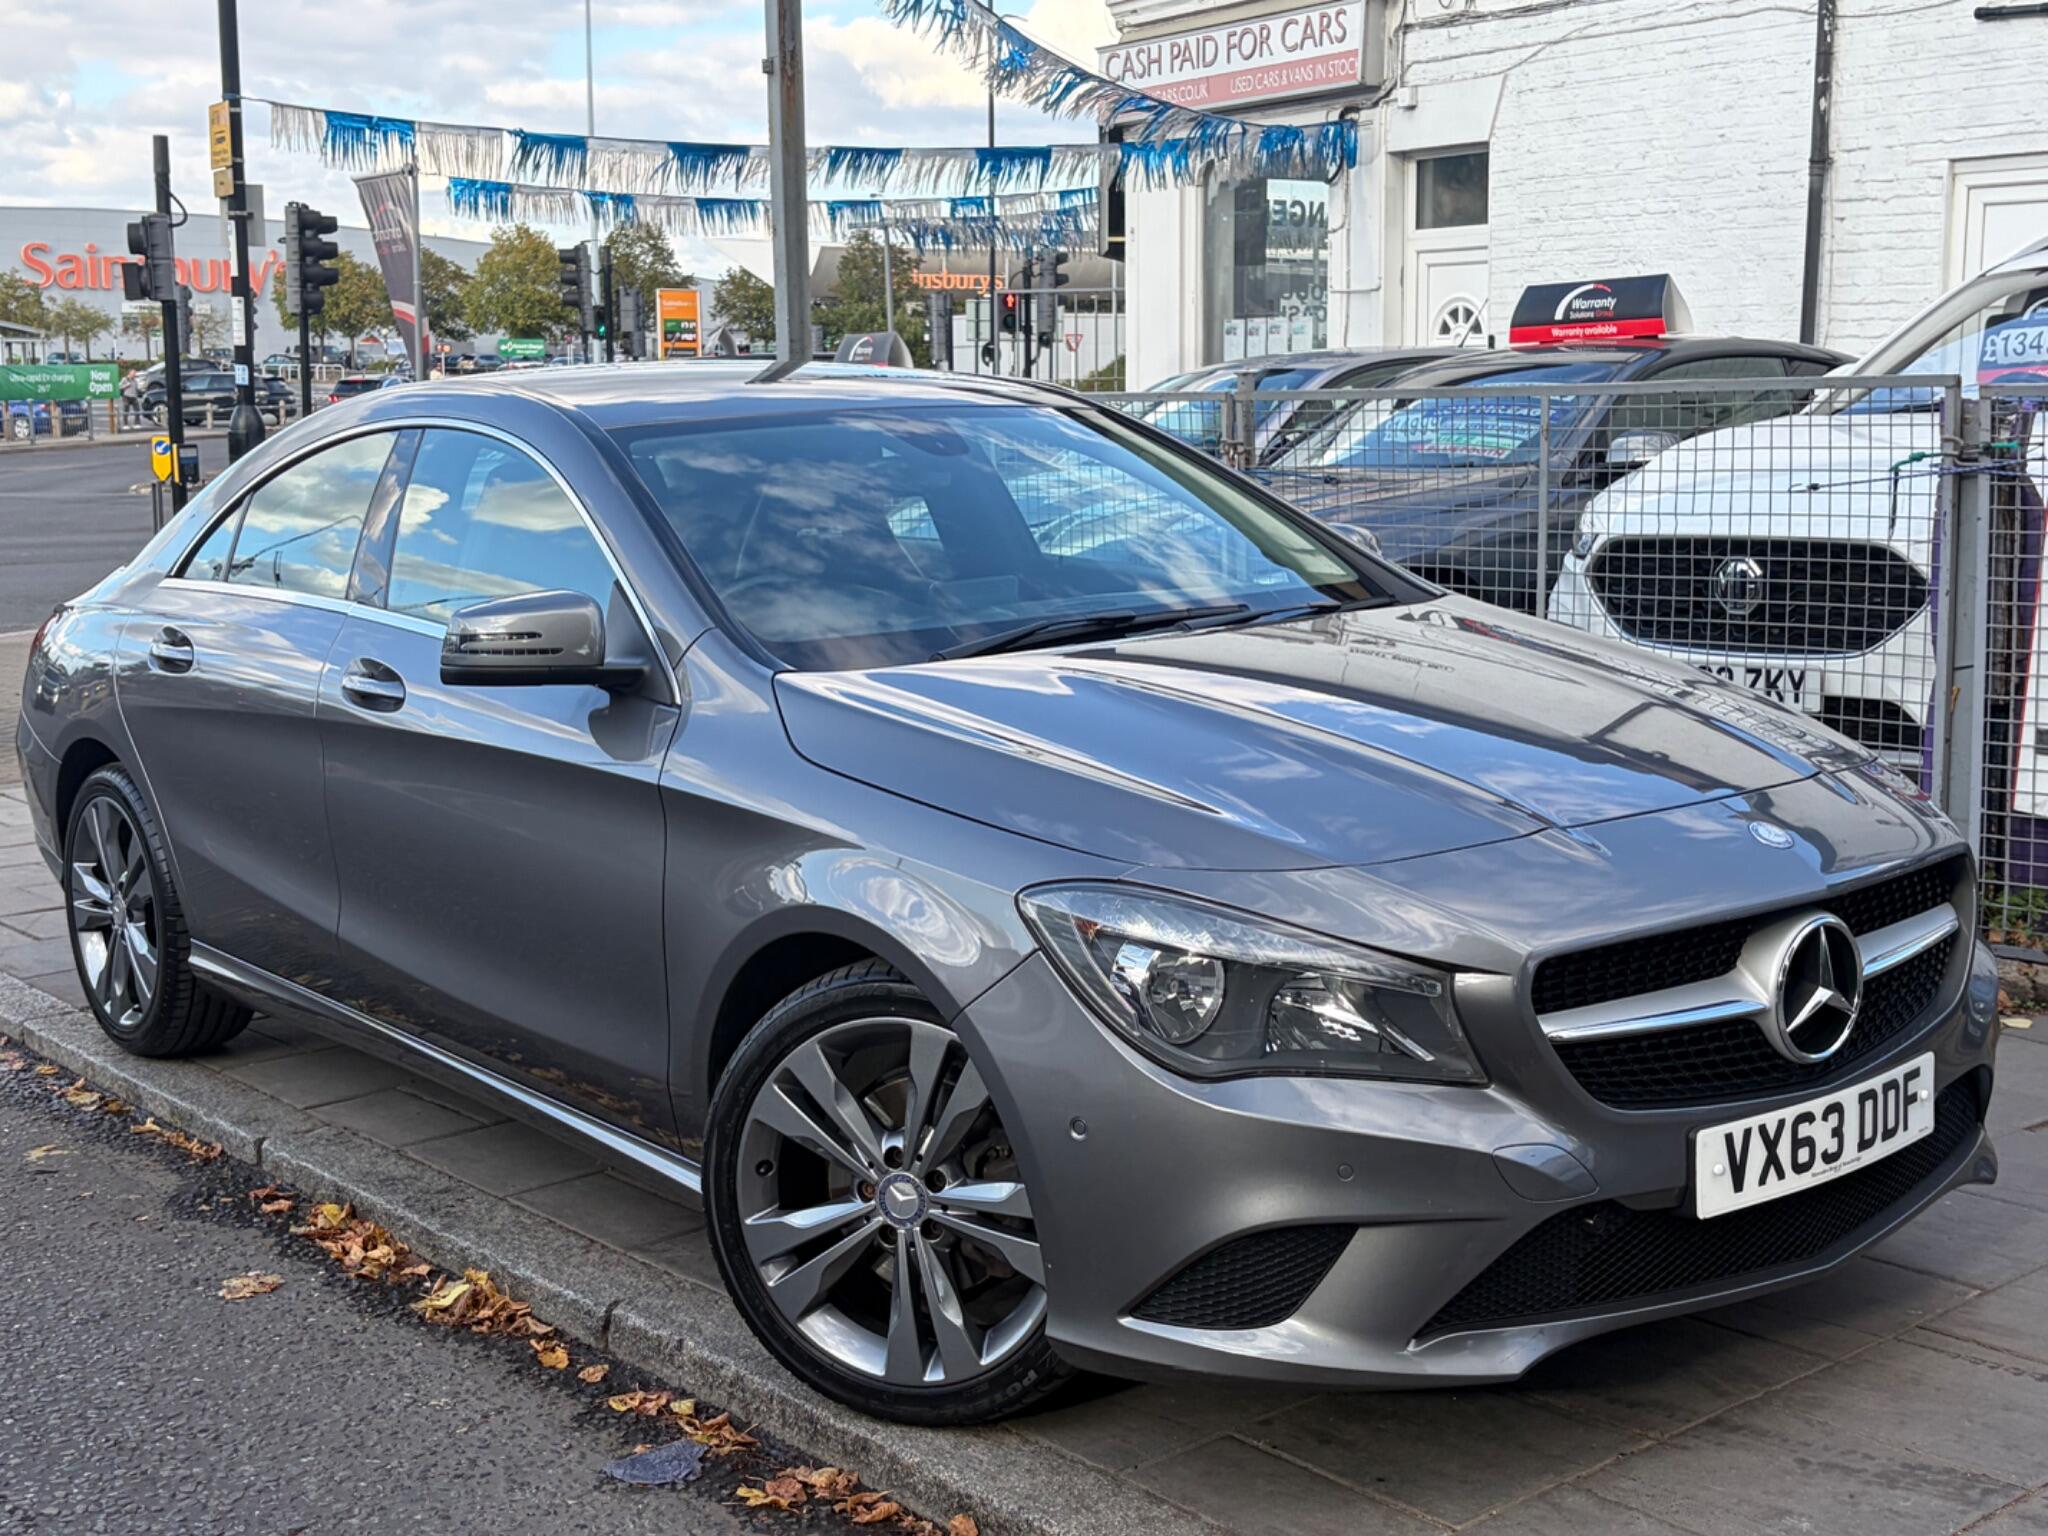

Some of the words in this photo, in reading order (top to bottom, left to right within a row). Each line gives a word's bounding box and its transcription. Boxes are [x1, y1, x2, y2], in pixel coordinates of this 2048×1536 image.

[1105, 44, 1162, 83] CASH
[1170, 35, 1219, 75] PAID
[1226, 24, 1274, 65] FOR
[1281, 8, 1348, 53] CARS
[1230, 76, 1254, 93] USED
[1254, 71, 1280, 90] CARS
[1281, 70, 1288, 85] &
[1288, 65, 1313, 84] VANS
[1314, 63, 1326, 79] IN
[1328, 57, 1358, 78] STOC
[1572, 296, 1617, 311] Warranty
[1551, 326, 1584, 338] Warranty
[1585, 323, 1618, 336] available
[1983, 330, 2048, 362] £134
[90, 370, 111, 381] Now
[89, 382, 113, 395] Open
[1725, 1102, 1845, 1194] VX63
[1857, 1066, 1921, 1153] DDF
